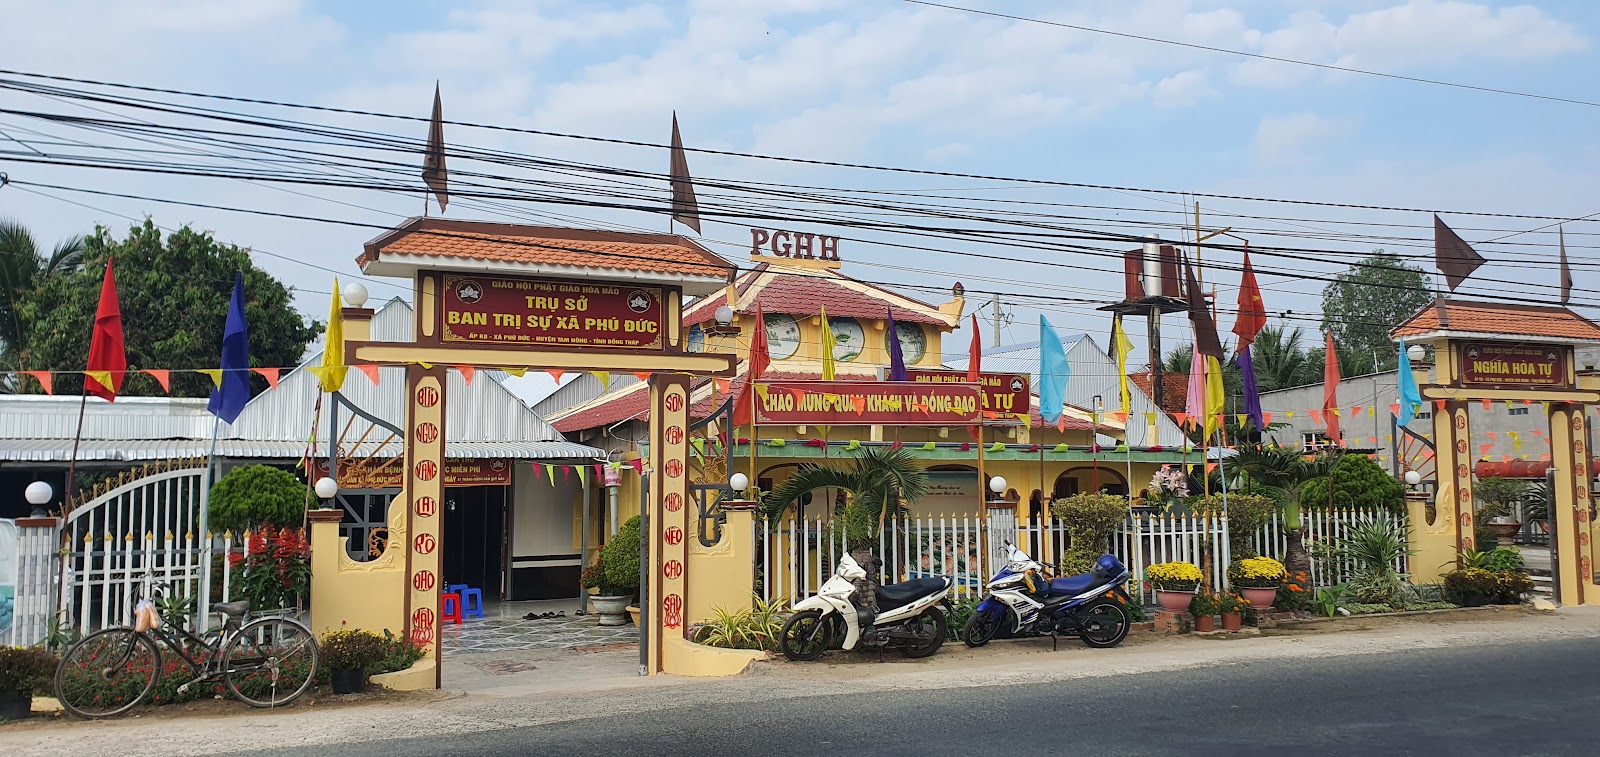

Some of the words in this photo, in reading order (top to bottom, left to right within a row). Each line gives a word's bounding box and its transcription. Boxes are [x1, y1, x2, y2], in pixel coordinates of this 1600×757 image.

[750, 228, 840, 261] PGHH
[525, 296, 559, 312] TRỤ
[564, 295, 589, 311] SỞ
[448, 311, 487, 325] BAN
[493, 313, 521, 330] TRỊ
[527, 315, 553, 331] SỰ
[556, 315, 580, 330] XÃ
[585, 316, 619, 332] PHÚ
[624, 318, 658, 334] ĐỨC
[1473, 360, 1510, 375] NGHĨA
[1512, 360, 1535, 376] HÒA
[1538, 362, 1553, 378] TỰ
[763, 389, 794, 412] CHÀO
[994, 393, 1015, 413] TỰ
[663, 559, 683, 580] CAO
